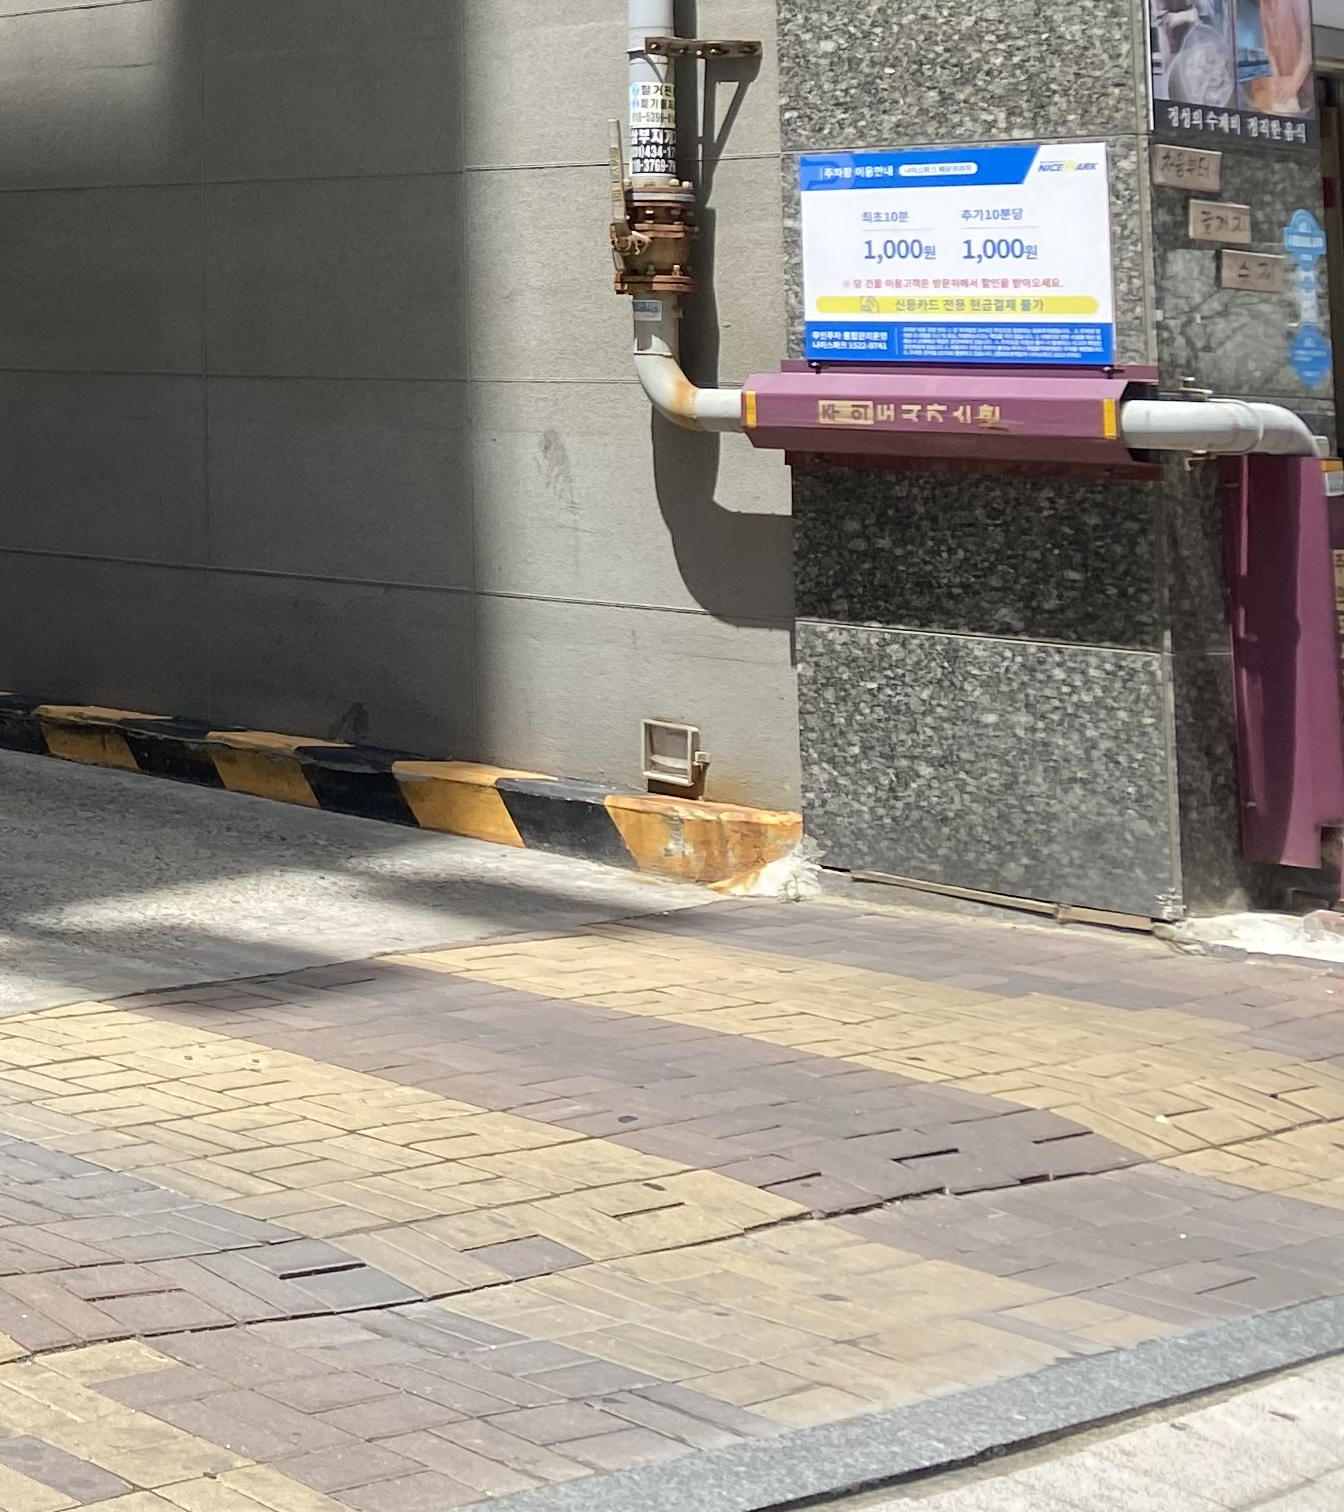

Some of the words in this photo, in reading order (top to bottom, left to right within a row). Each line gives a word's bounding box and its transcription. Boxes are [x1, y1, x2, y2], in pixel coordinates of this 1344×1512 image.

[1206, 110, 1242, 135] 수제비
[1284, 121, 1307, 144] 음식
[823, 167, 853, 179] 주차장
[855, 165, 894, 178] 이용안내
[961, 208, 1023, 222] 추가10분당
[863, 238, 937, 265] 1,000원
[962, 237, 1039, 264] 1,000원
[896, 298, 941, 312] 신용카드
[943, 298, 966, 312] 전용
[969, 298, 1017, 312] 현금결제
[1020, 298, 1045, 312] 불가
